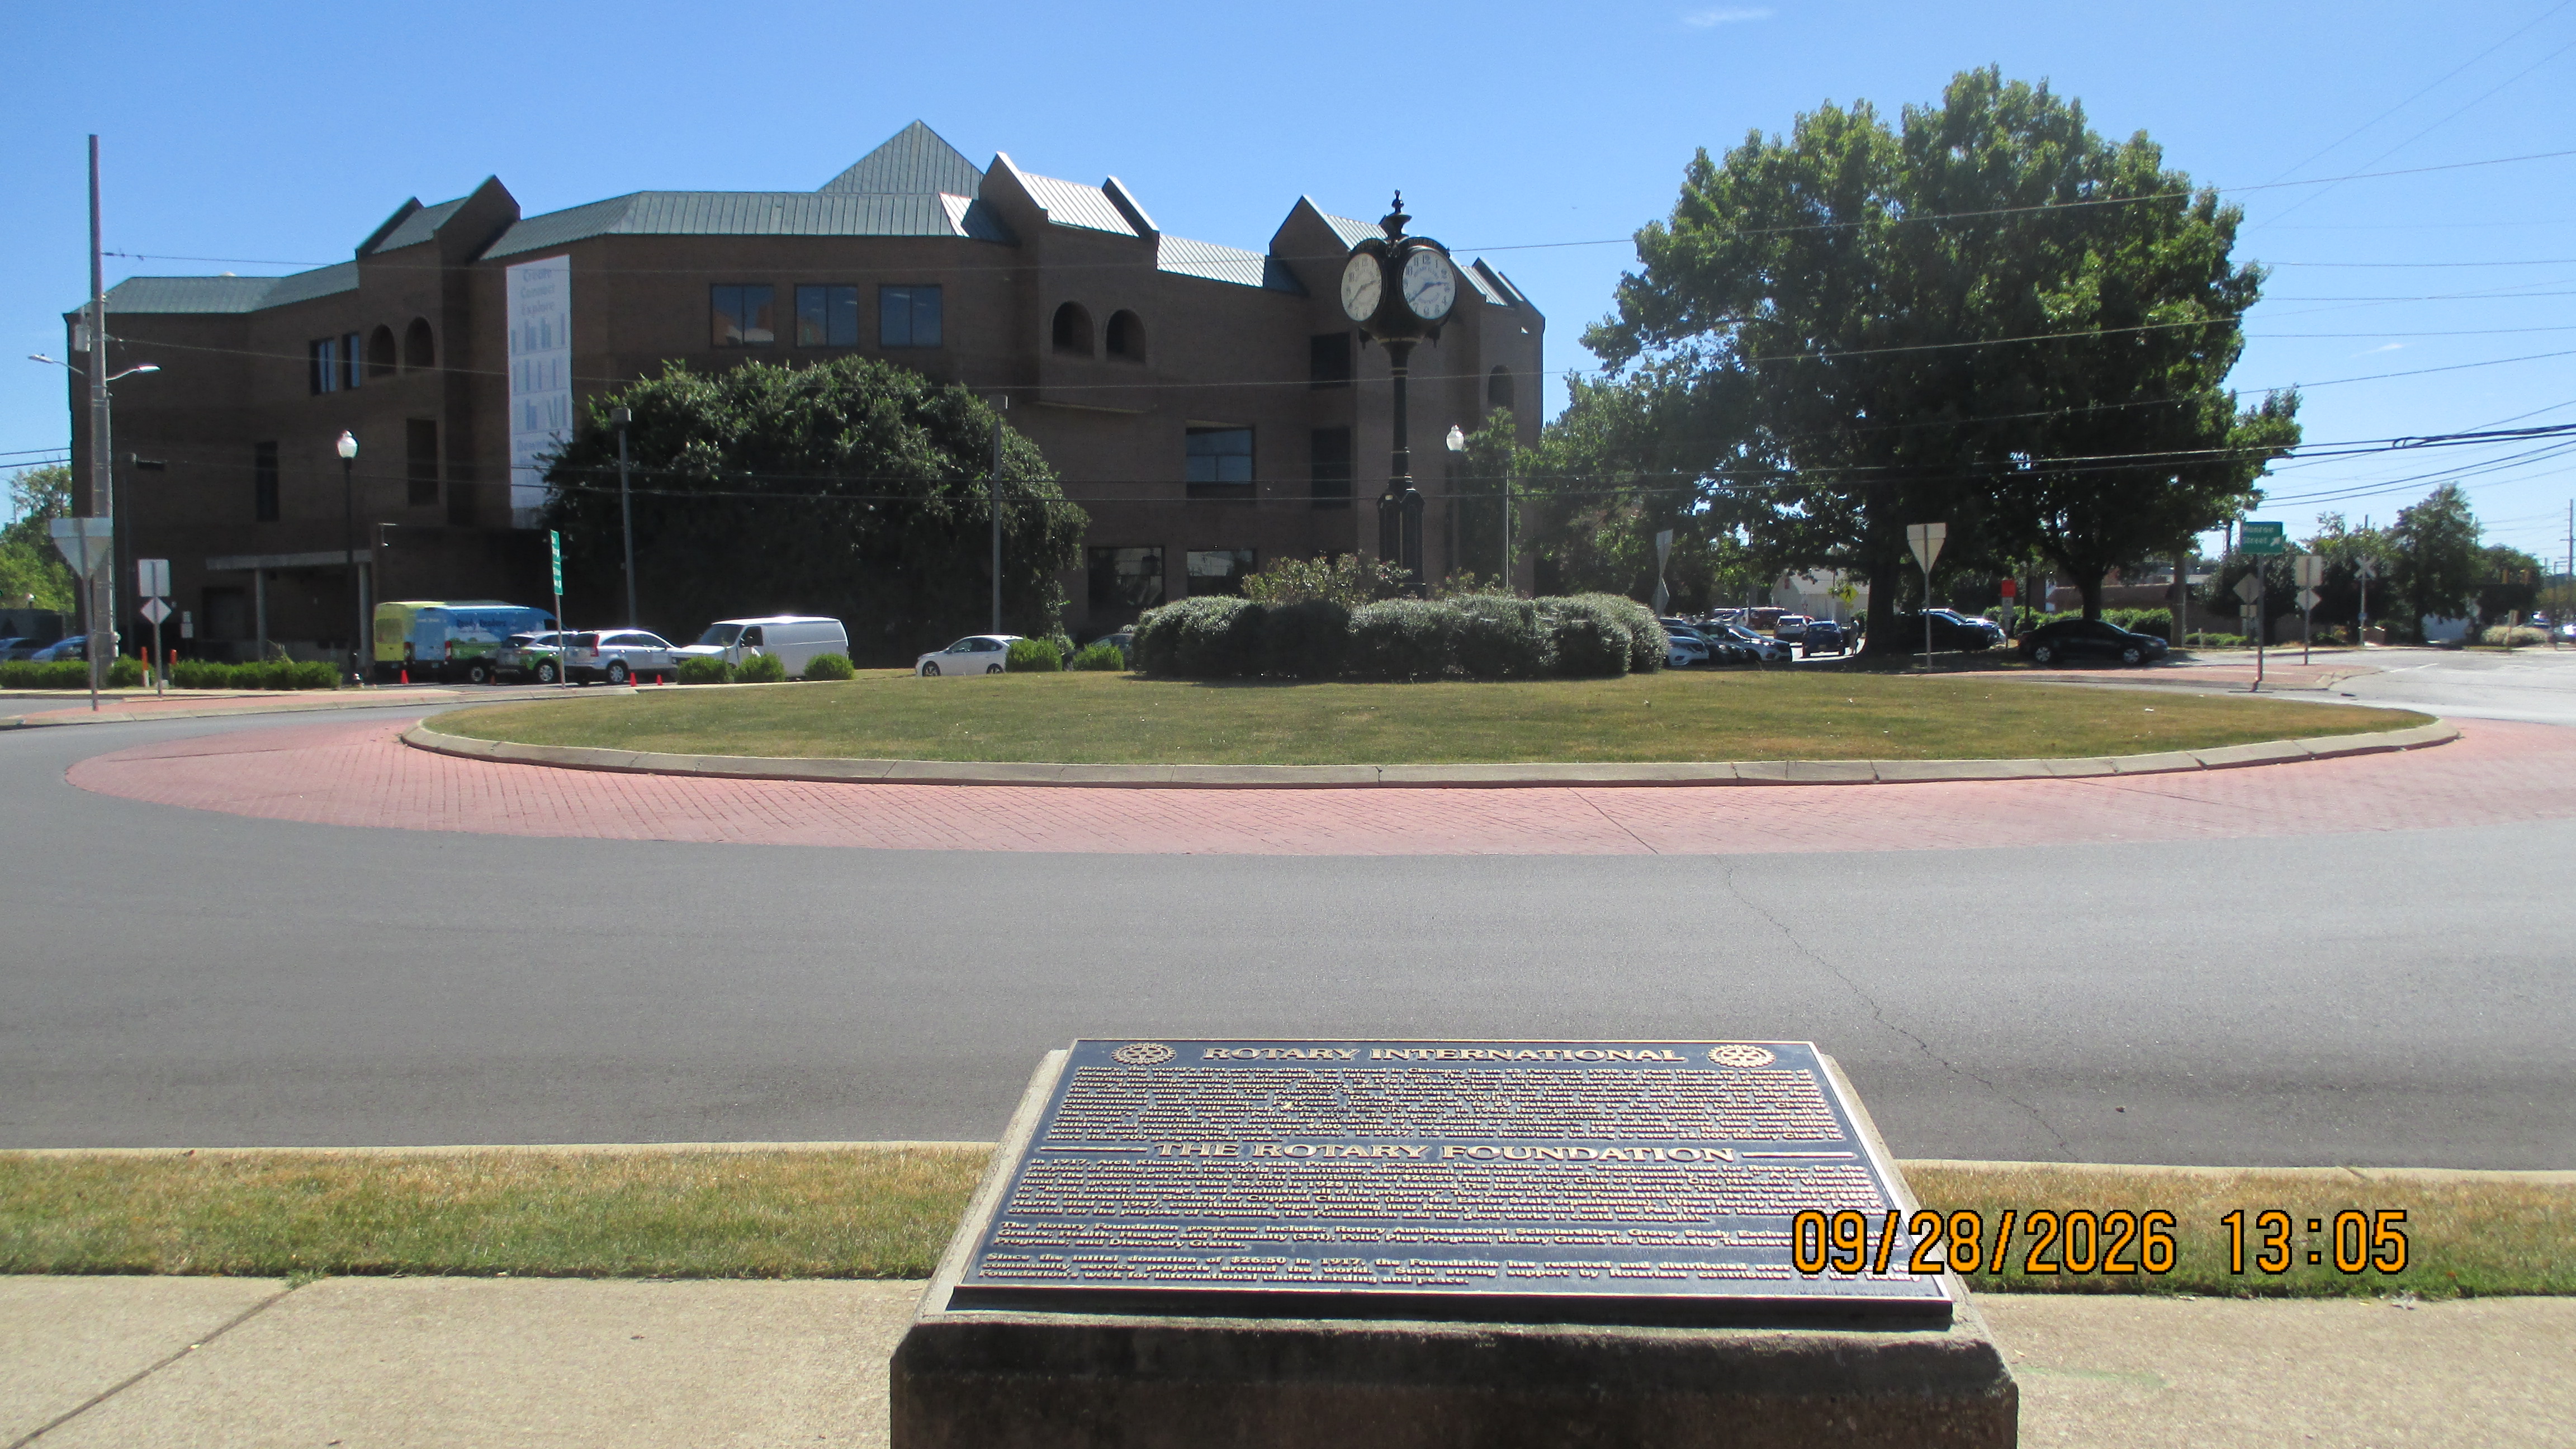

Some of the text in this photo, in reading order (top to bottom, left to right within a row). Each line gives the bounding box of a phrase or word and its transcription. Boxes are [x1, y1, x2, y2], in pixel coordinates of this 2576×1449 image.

[1423, 254, 1431, 265] 12
[523, 269, 551, 282] Create
[521, 301, 555, 317] Explore
[1204, 1048, 1686, 1062] ROTARY INTERNATIONAL
[1154, 1143, 1735, 1162] THE ROTARY FOUNDATION
[1109, 1239, 1185, 1247] Discovery
[1637, 1238, 1715, 1246] University
[983, 1261, 1070, 1270] community
[1146, 1263, 1210, 1272] projects
[1445, 1268, 1496, 1276] strong
[1506, 1268, 1569, 1277] support
[1579, 1270, 1598, 1278] by
[1697, 1271, 1790, 1280] contributes
[1230, 1257, 1286, 1265] $26.50
[1658, 1262, 1746, 1271] distributed
